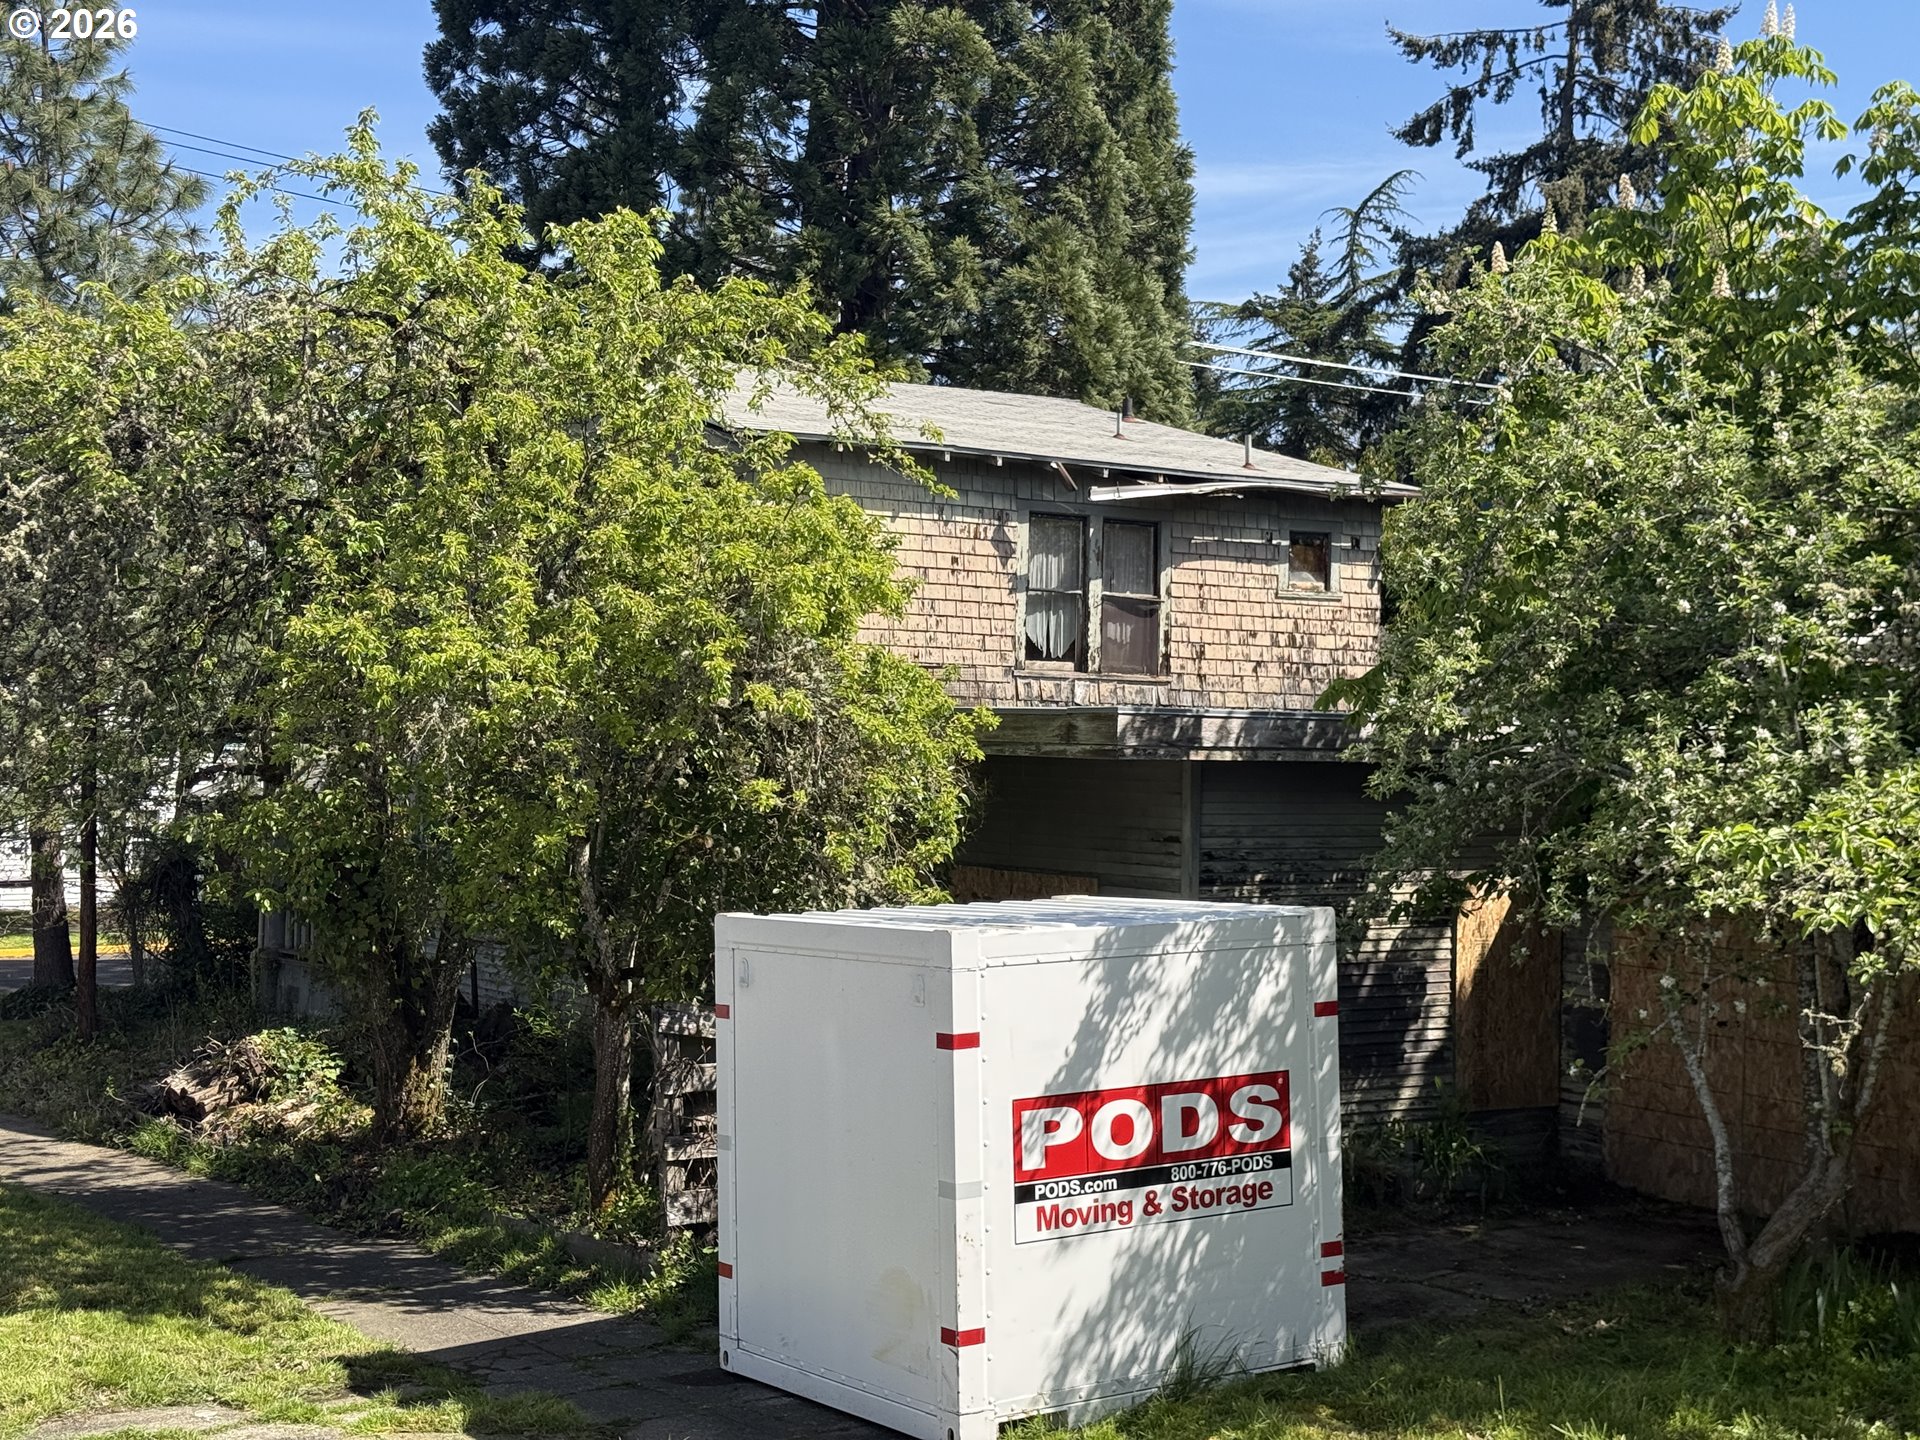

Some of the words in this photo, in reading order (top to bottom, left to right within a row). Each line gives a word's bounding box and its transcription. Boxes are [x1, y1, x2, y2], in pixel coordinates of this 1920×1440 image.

[1020, 1084, 1283, 1172] PODS
[1034, 1178, 1118, 1199] PODS.com
[1171, 1154, 1273, 1181] 800-776-PODS
[1036, 1199, 1133, 1232] Moving
[1142, 1190, 1163, 1217] &
[1171, 1181, 1273, 1212] Storage
